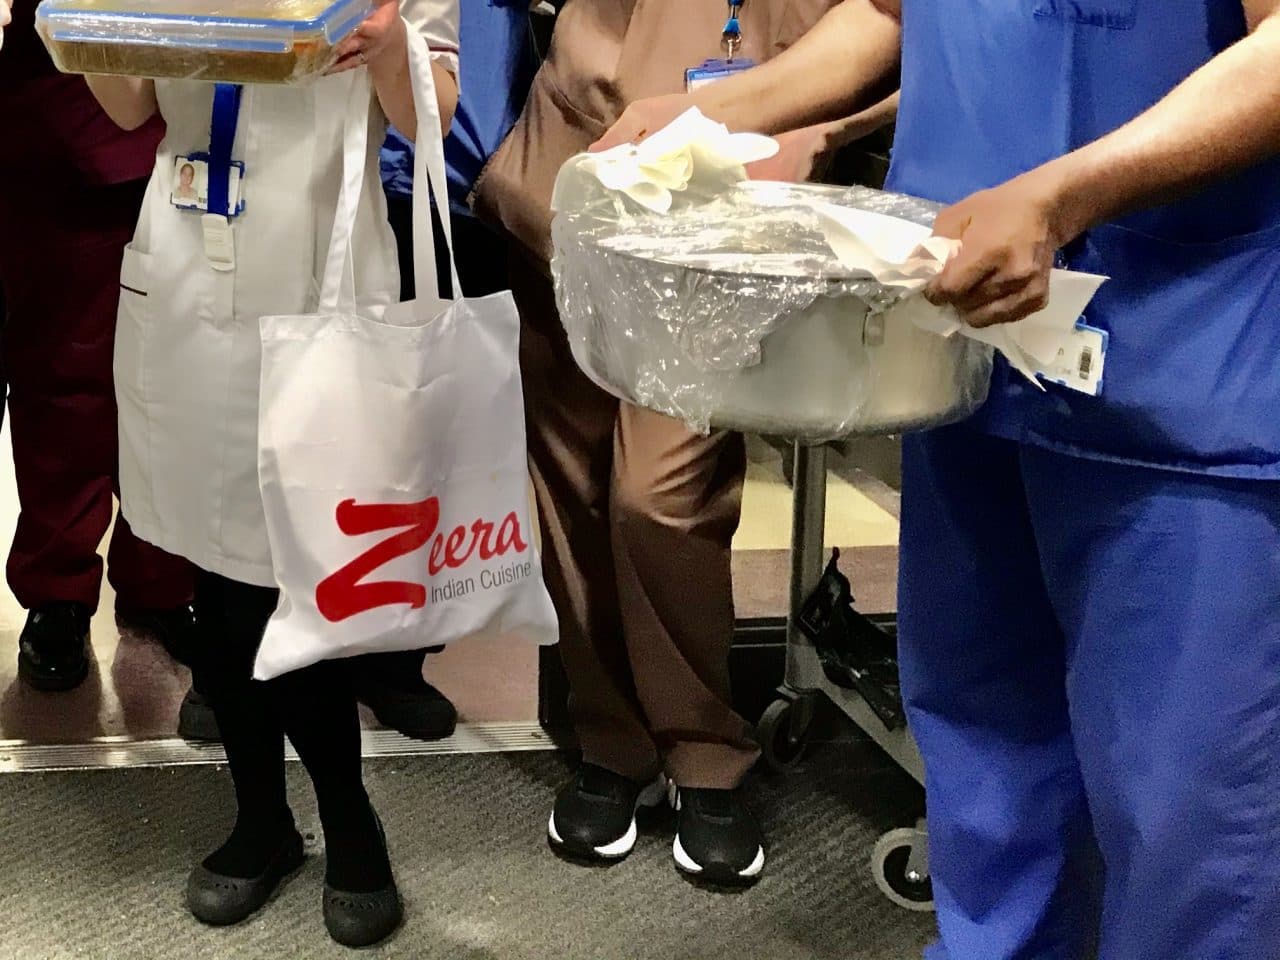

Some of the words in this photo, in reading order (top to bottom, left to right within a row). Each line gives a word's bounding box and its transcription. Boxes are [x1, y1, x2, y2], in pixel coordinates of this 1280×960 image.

[315, 496, 527, 623] Zeera
[431, 576, 475, 604] Indian
[480, 560, 532, 589] Cuisine
